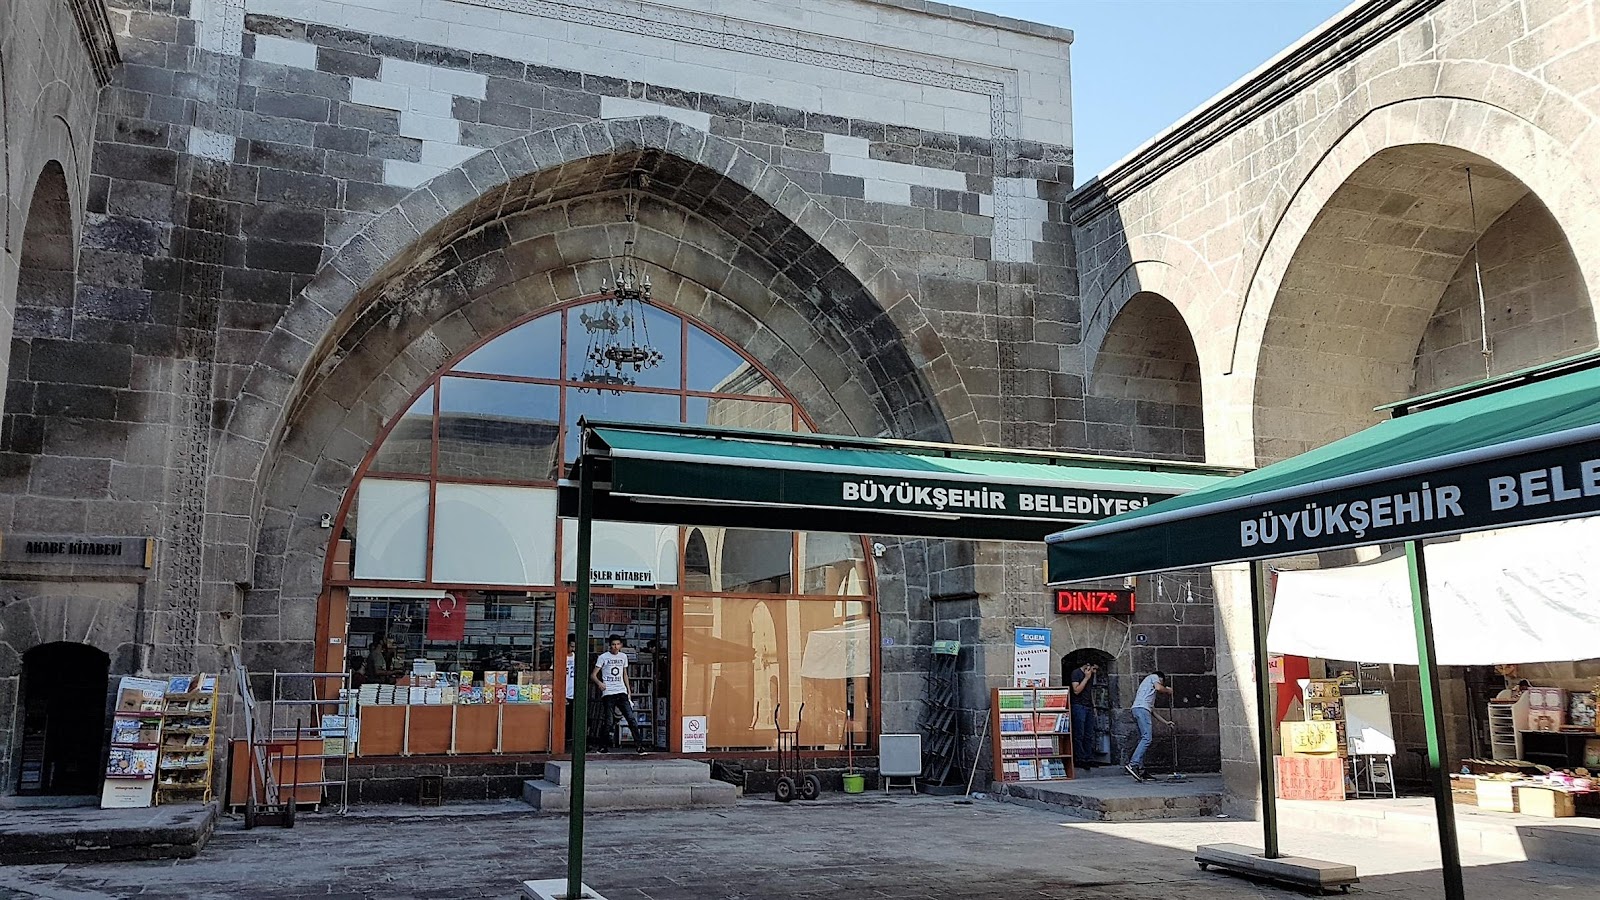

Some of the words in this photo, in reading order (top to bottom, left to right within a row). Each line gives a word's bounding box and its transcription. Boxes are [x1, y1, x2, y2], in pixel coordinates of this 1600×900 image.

[842, 480, 1006, 510] BÜYÜKŞEHİR
[1240, 481, 1465, 547] BÜYÜKŞEHİR
[1489, 458, 1600, 511] BELE
[25, 541, 66, 554] AKABE
[68, 540, 122, 556] KİTABEVİ
[615, 569, 652, 582] KİTABEVİ
